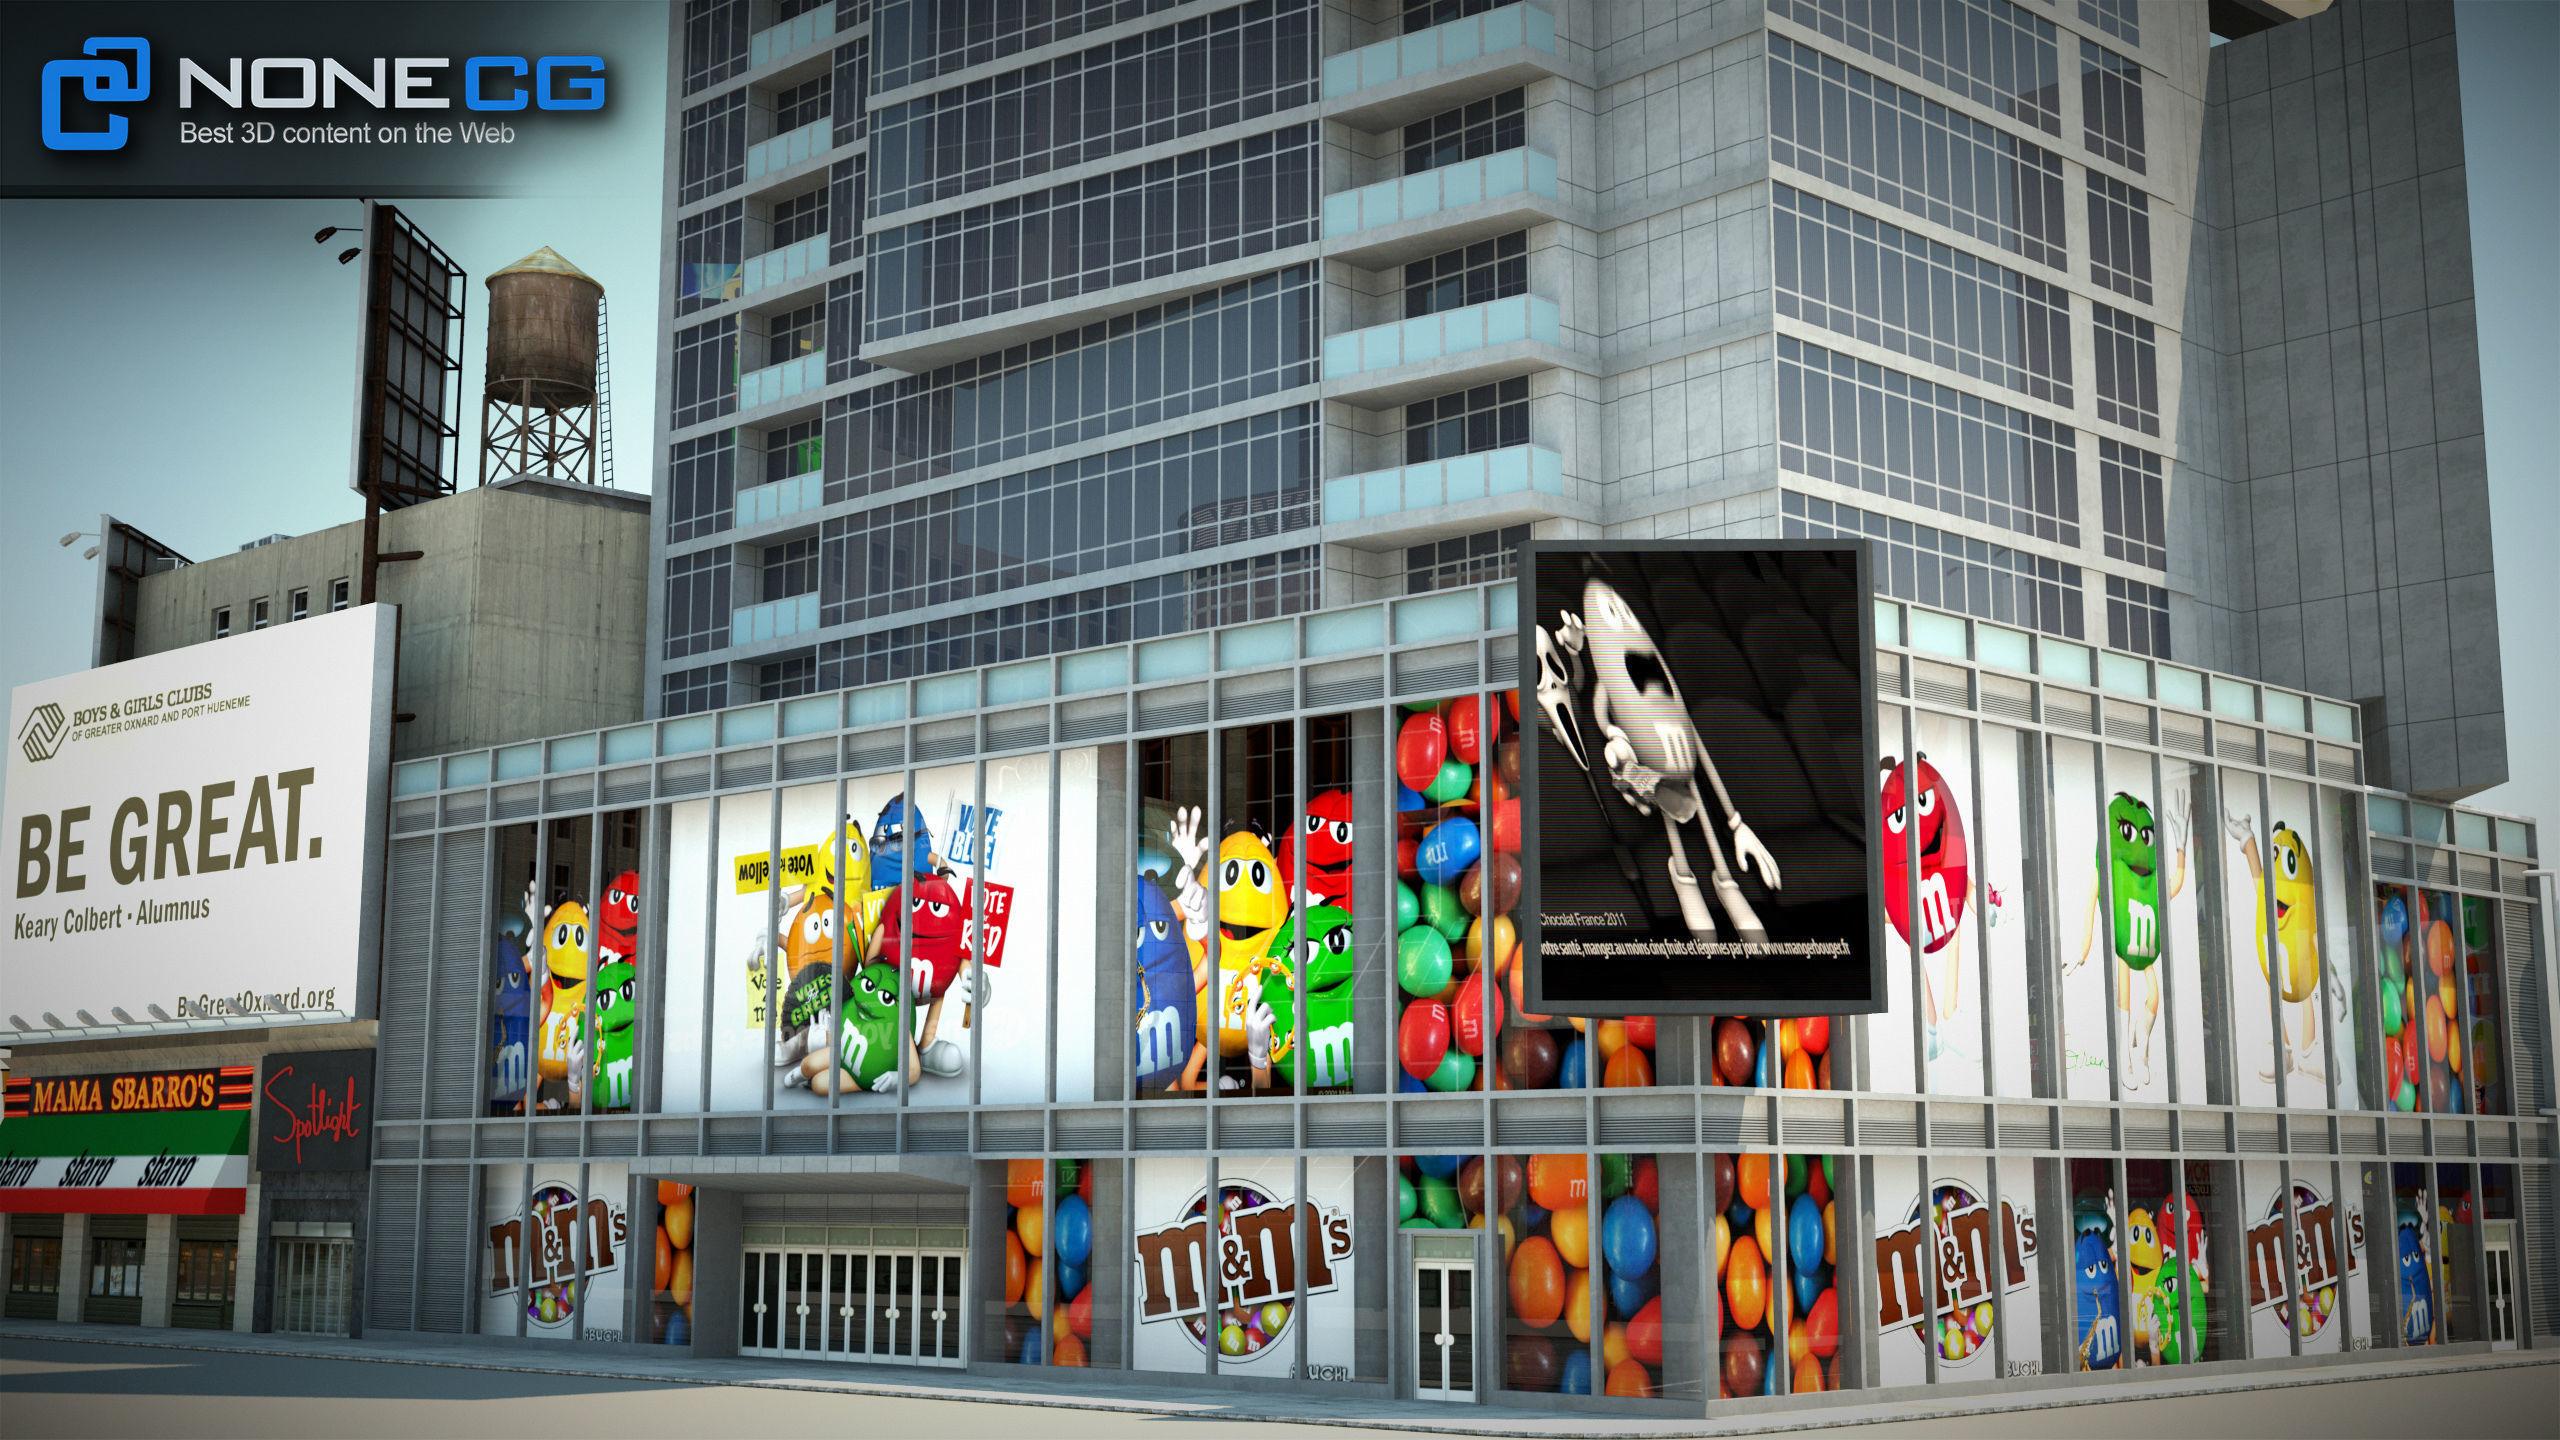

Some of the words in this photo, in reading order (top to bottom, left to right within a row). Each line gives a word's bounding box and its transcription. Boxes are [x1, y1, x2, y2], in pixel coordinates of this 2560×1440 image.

[72, 730, 83, 742] OF
[84, 722, 122, 740] GREATER
[124, 714, 159, 732] OXNARD
[161, 710, 179, 724] AND
[181, 704, 204, 720] PORT
[207, 695, 251, 715] HUENEME
[73, 705, 107, 727] BOYS
[110, 703, 121, 719] &
[124, 693, 164, 716] GIRLS
[167, 682, 213, 707] CLUBS
[16, 805, 91, 899] BE
[110, 767, 323, 886] GREAT.
[951, 831, 994, 869] BLE
[738, 860, 770, 885] ellow
[788, 853, 814, 877] Vote
[14, 912, 58, 941] Keary
[64, 904, 122, 935] Colbert
[136, 897, 210, 926] Alumnus
[970, 886, 1007, 915] OTE
[1604, 911, 1627, 926] 2011
[2127, 898, 2156, 959] m
[751, 973, 782, 990] Voe
[176, 986, 336, 1018] BGretOxrd.org
[790, 987, 832, 1027] GREE
[33, 1080, 104, 1114] MAMA
[110, 1073, 215, 1112] SBARRO'S
[264, 1065, 361, 1165] Spotlight
[0, 1150, 39, 1188] barro
[58, 1148, 116, 1188] sbarro
[137, 1147, 198, 1188] sbarro
